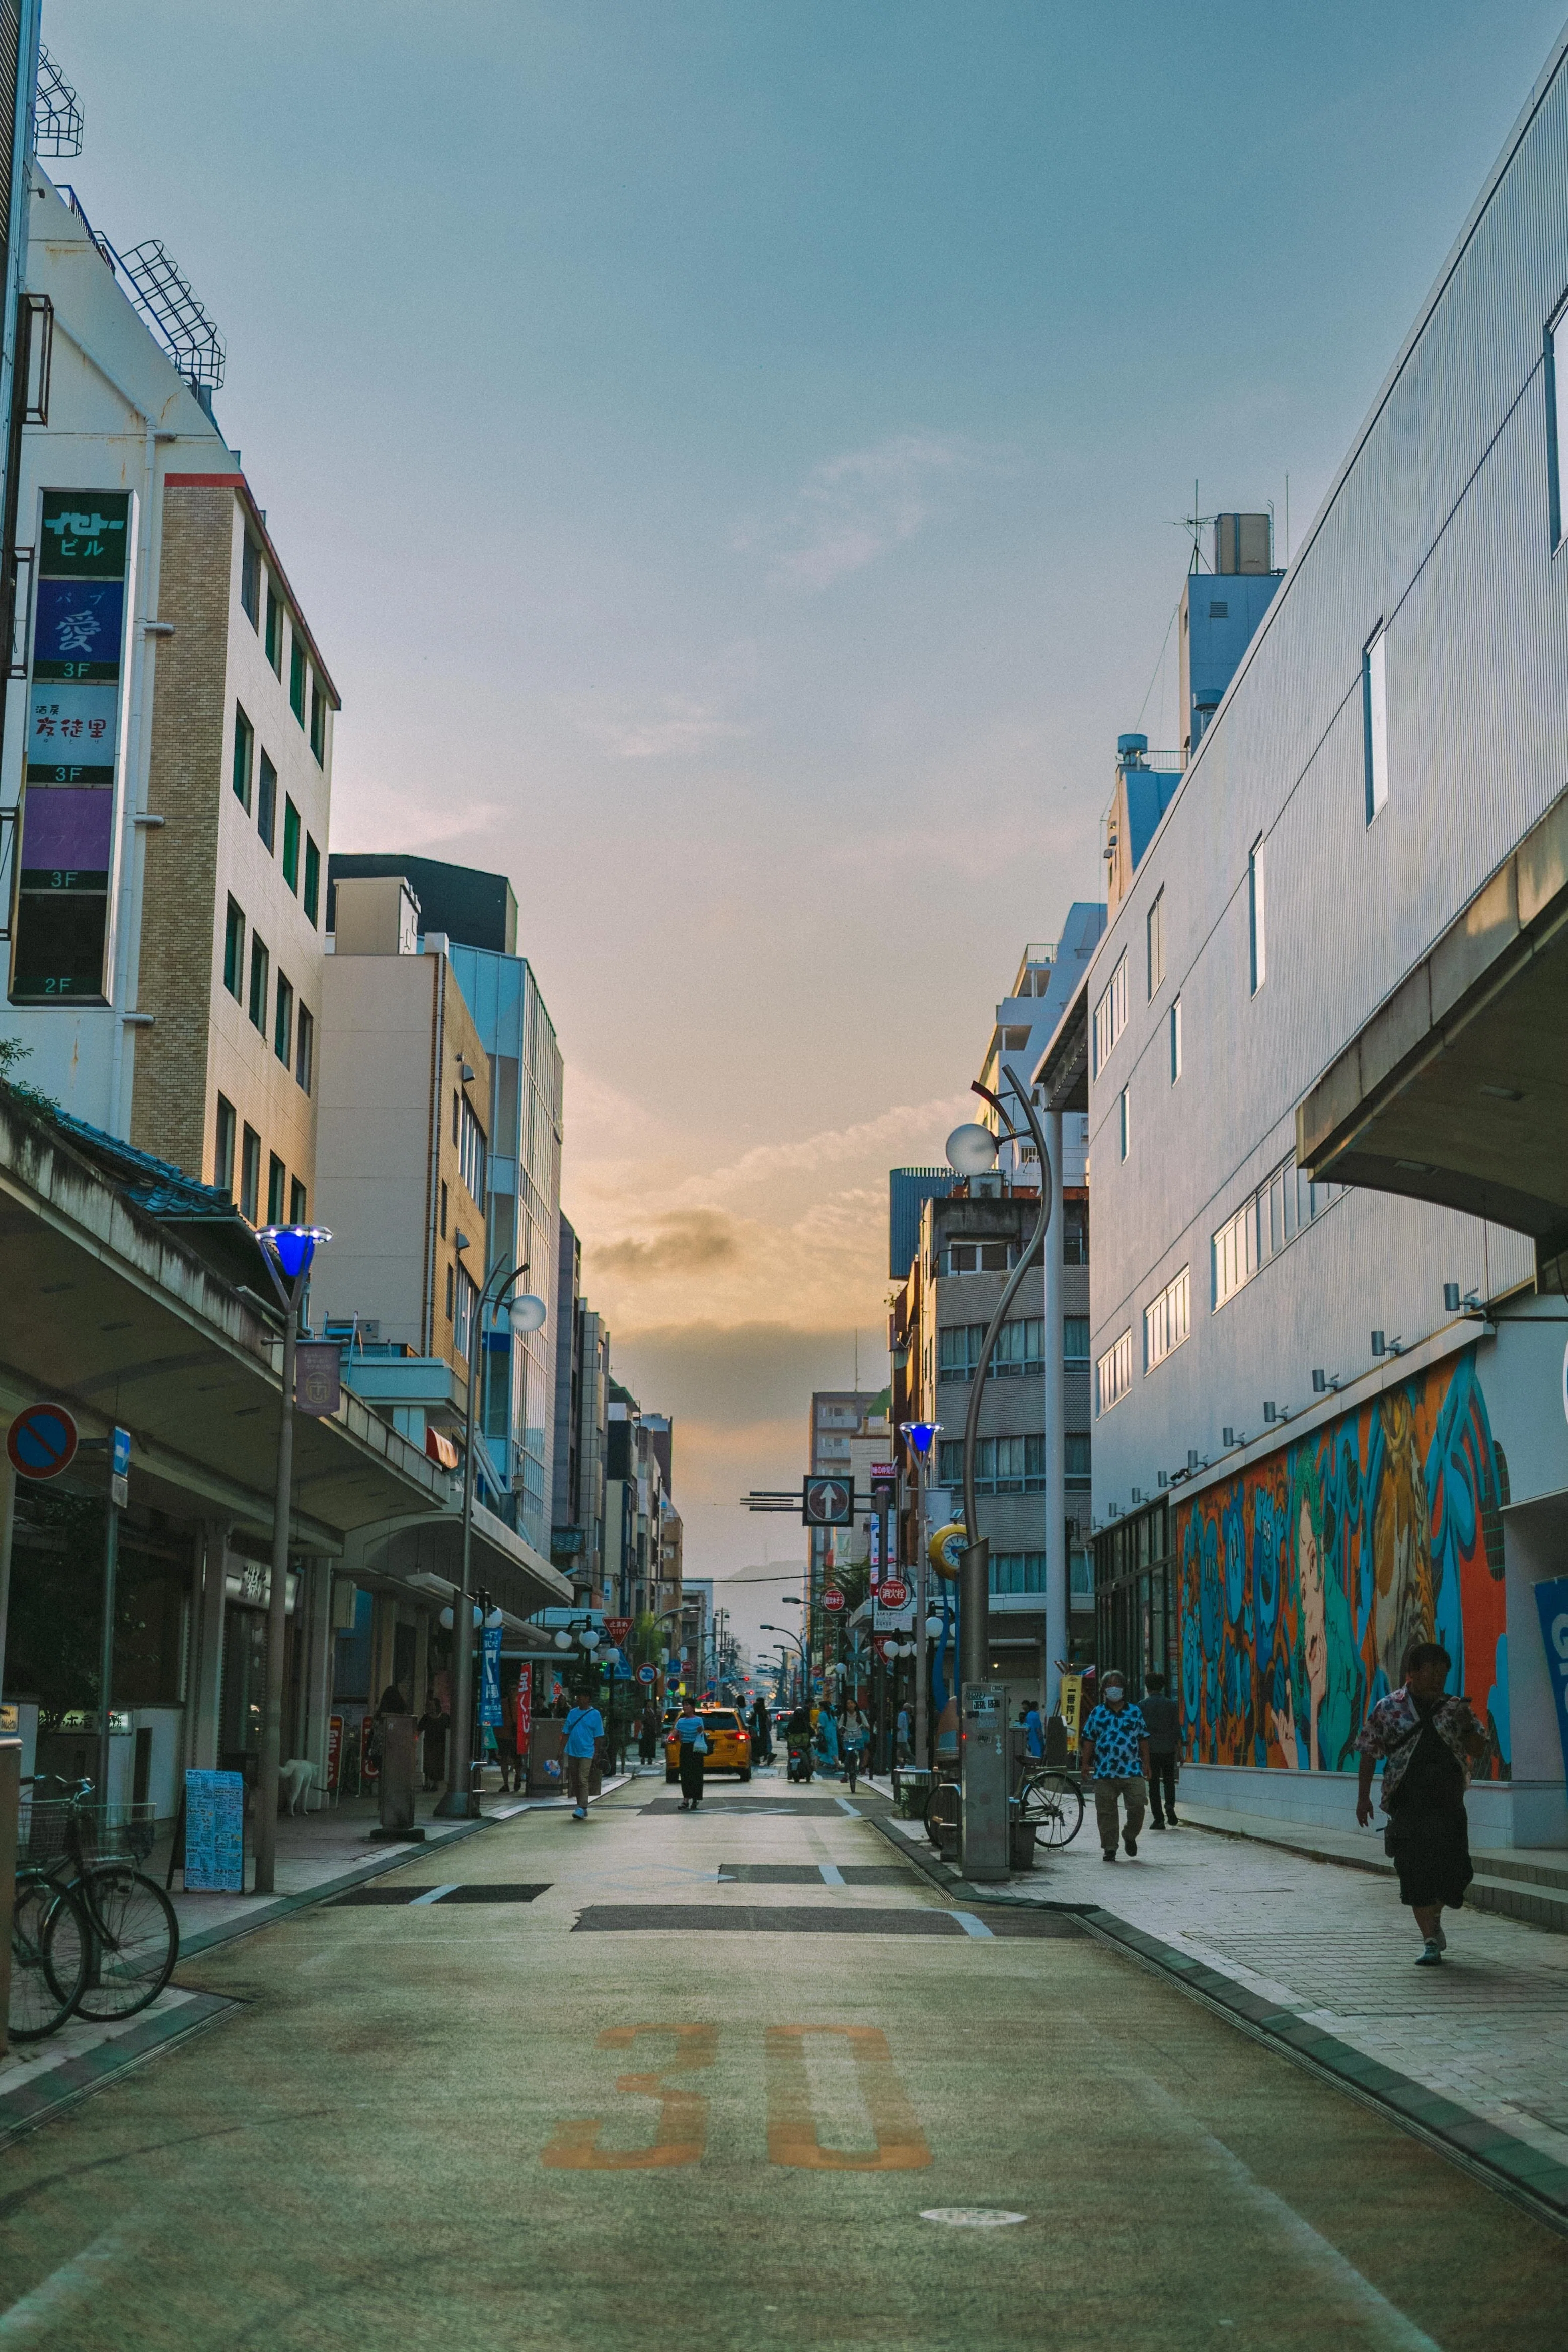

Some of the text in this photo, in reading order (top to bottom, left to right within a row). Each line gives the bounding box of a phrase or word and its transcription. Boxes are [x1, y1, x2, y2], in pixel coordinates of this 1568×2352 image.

[61, 539, 104, 556] ビル
[54, 610, 101, 653] 愛
[63, 663, 90, 677] 3F
[35, 704, 60, 715] 酒房
[55, 767, 83, 782] 3F
[51, 871, 78, 887] 3F
[45, 978, 72, 993] 2F
[882, 1588, 905, 1599] 消火栓
[518, 1671, 530, 1733] 宝くじ
[1066, 1688, 1076, 1725] 一番搾り
[539, 2023, 934, 2171] 30
